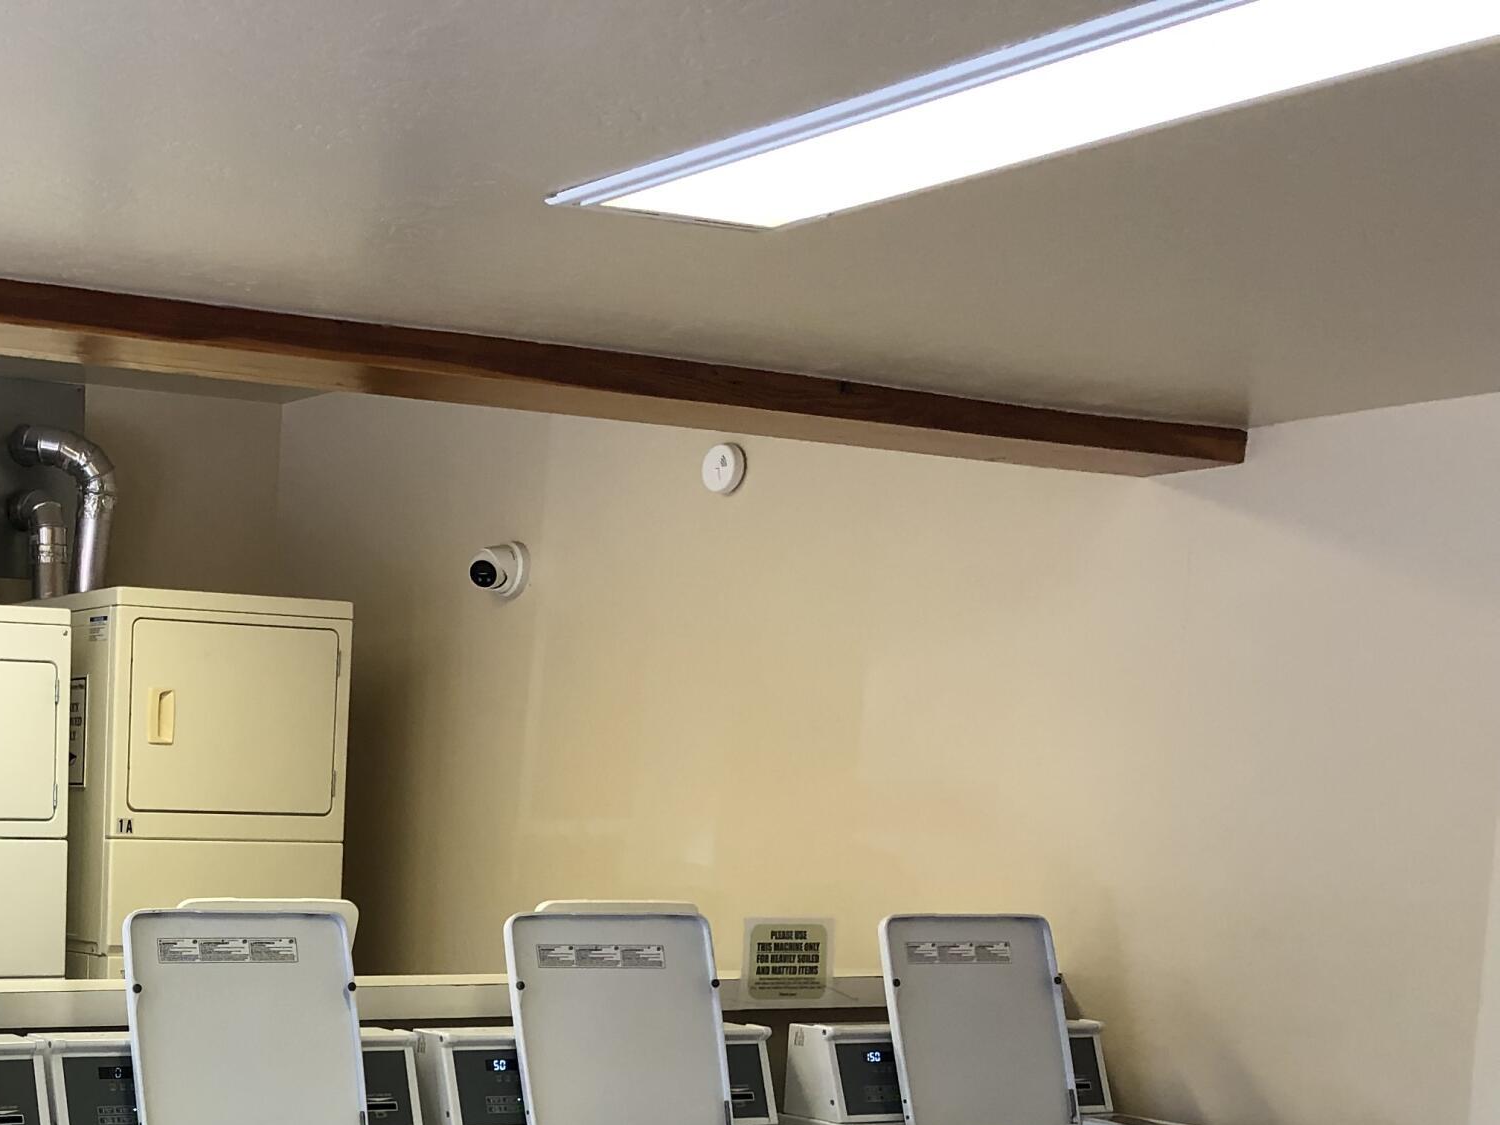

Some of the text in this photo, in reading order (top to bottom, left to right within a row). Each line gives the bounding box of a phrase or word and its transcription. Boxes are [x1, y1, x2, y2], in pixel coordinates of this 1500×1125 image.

[770, 930, 807, 940] PLEASE USE
[757, 942, 820, 952] THIS MACHINE ONLY
[756, 954, 820, 964] FOR HEAVILY SOILED
[755, 966, 819, 975] AND MATTED ITEMS
[493, 1059, 506, 1071] 50
